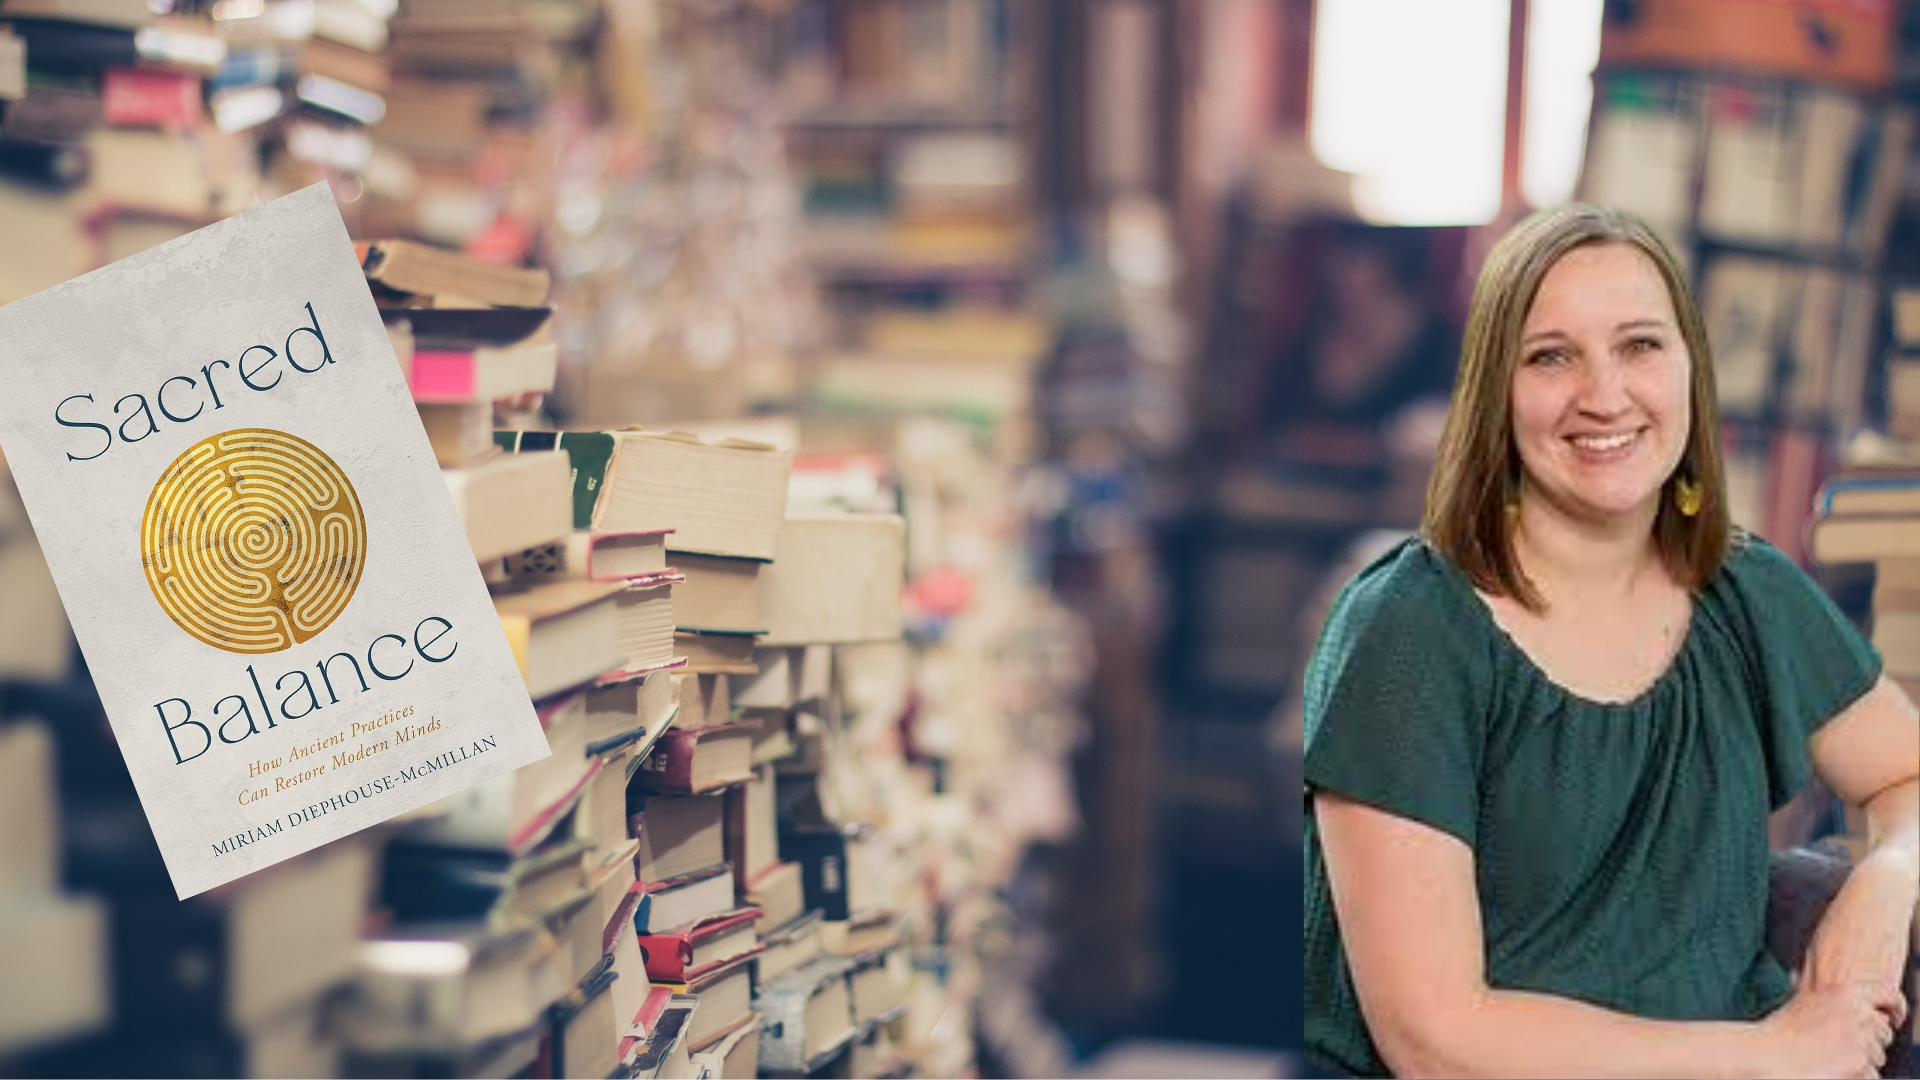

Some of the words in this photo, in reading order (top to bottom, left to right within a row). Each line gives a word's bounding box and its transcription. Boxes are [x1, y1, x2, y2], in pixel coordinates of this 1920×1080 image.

[54, 301, 337, 462] Sacred
[153, 615, 459, 766] Balance
[248, 762, 283, 779] How
[289, 730, 345, 764] Ancient
[350, 704, 415, 738] Practices
[211, 818, 284, 858] MIRIAM
[287, 734, 498, 828] DIEPHOUSE-McMILLAN
[237, 785, 269, 806] Can
[274, 763, 326, 793] Restore
[331, 740, 390, 772] Modern
[395, 715, 442, 747] Minds
